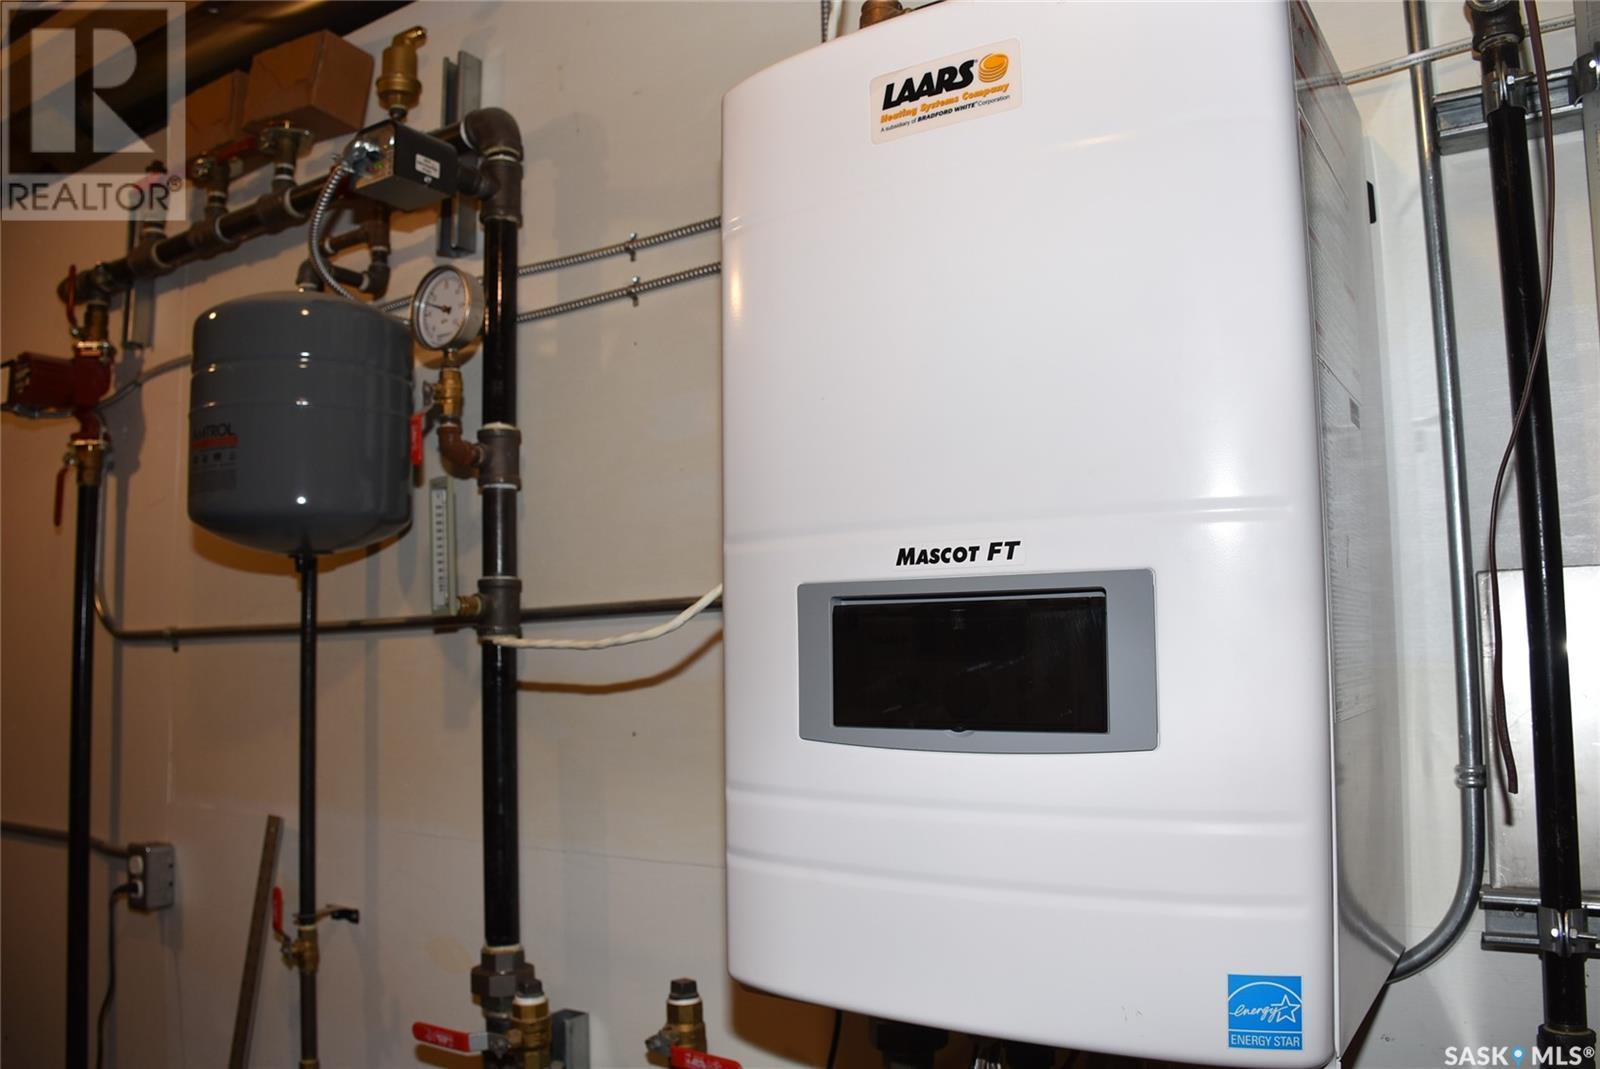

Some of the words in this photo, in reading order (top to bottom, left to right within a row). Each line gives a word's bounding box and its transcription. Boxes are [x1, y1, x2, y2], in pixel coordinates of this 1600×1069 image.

[882, 59, 975, 111] LAARS
[880, 107, 918, 123] Heating
[920, 96, 959, 113] Systems
[962, 83, 1009, 101] Company
[917, 107, 953, 123] BRADFORD
[987, 540, 1021, 561] FT
[1230, 1004, 1279, 1023] energy
[1231, 1034, 1272, 1047] ENERGY
[1273, 1035, 1301, 1048] STAR
